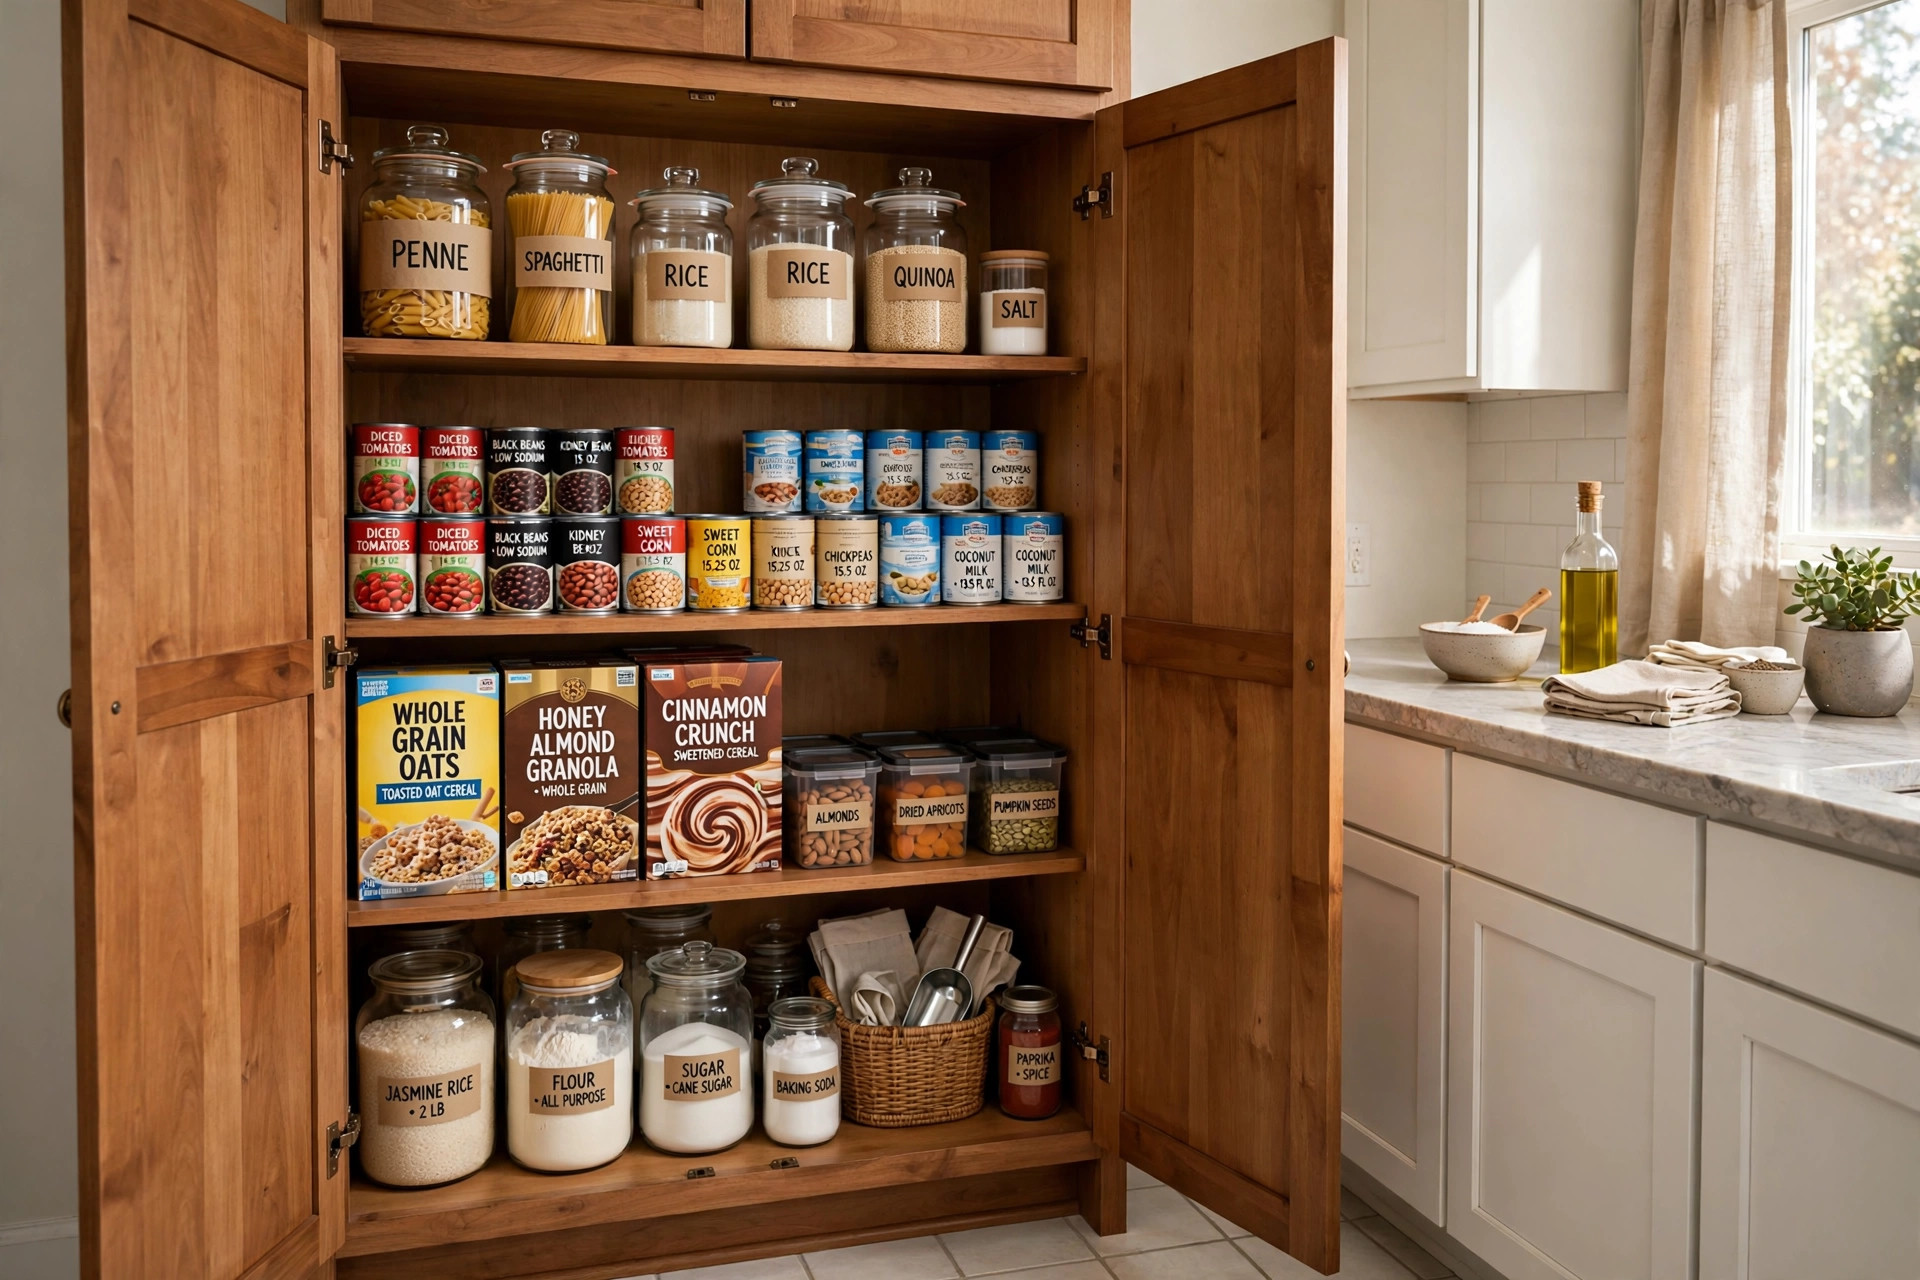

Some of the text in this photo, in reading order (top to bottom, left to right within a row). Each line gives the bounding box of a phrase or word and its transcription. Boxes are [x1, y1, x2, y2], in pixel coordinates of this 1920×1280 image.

[392, 239, 469, 272] PENNE
[524, 251, 604, 275] SPAGHETTI
[665, 263, 709, 288] RICE
[787, 261, 830, 285] RICE
[893, 265, 955, 290] QUINOA
[1001, 299, 1038, 320] SALT
[370, 431, 403, 442] DICED
[439, 434, 470, 445] DICED
[361, 443, 412, 454] TOMATOES
[429, 446, 478, 457] TOMATOES
[492, 439, 546, 451] BLACK BEANS
[494, 452, 545, 463] LOW SODIUM
[574, 454, 599, 465] 15 OZ
[652, 462, 663, 472] OZ
[366, 527, 400, 539] DICED
[437, 528, 470, 539] DICED
[495, 532, 549, 543] BLACK BEANS
[568, 529, 606, 541] KIDNEY
[637, 525, 676, 537] SWEET
[703, 528, 740, 541] SWEET
[356, 540, 410, 552] TOMATOES
[428, 540, 479, 552] TOMATOES
[496, 545, 548, 557] LOW SODIUM
[640, 539, 672, 553] CORN
[707, 544, 737, 557] CORN
[824, 550, 873, 563] CHICKPEAS
[954, 550, 996, 563] COCONUT
[1015, 549, 1057, 561] COCONUT
[728, 558, 741, 571] OZ
[793, 559, 805, 571] OZ
[834, 565, 867, 577] 15.5 OZ
[965, 565, 989, 576] MILK
[1027, 563, 1050, 575] MILK
[393, 701, 466, 726] WHOLE
[662, 695, 767, 722] CINNAMON
[539, 705, 607, 730] HONEY
[392, 725, 466, 754] GRAIN
[675, 720, 755, 747] CRUNCH
[529, 730, 615, 757] ALMOND
[673, 746, 759, 761] SWEETENED CEREAL
[400, 752, 460, 781] OATS
[526, 755, 620, 783] GRANOLA
[381, 783, 477, 800] TOASTED OAT CEREAL
[541, 782, 607, 797] WHOLE GRAIN
[899, 802, 965, 818] DRIED APRICOTS
[993, 797, 1056, 813] PUMPKIN SEEDS
[815, 809, 860, 824] ALMONDS
[1016, 1051, 1055, 1066] PAPRIKA
[682, 1059, 725, 1078] SUGAR
[1022, 1067, 1050, 1080] SPICE
[385, 1074, 474, 1102] JASMINE RICE
[552, 1071, 595, 1091] FLOUR
[672, 1075, 733, 1094] CANE SUGAR
[776, 1075, 836, 1094] BAKING SODA
[541, 1087, 606, 1108] ALL PURPOSE
[418, 1102, 445, 1119] 2 LB
